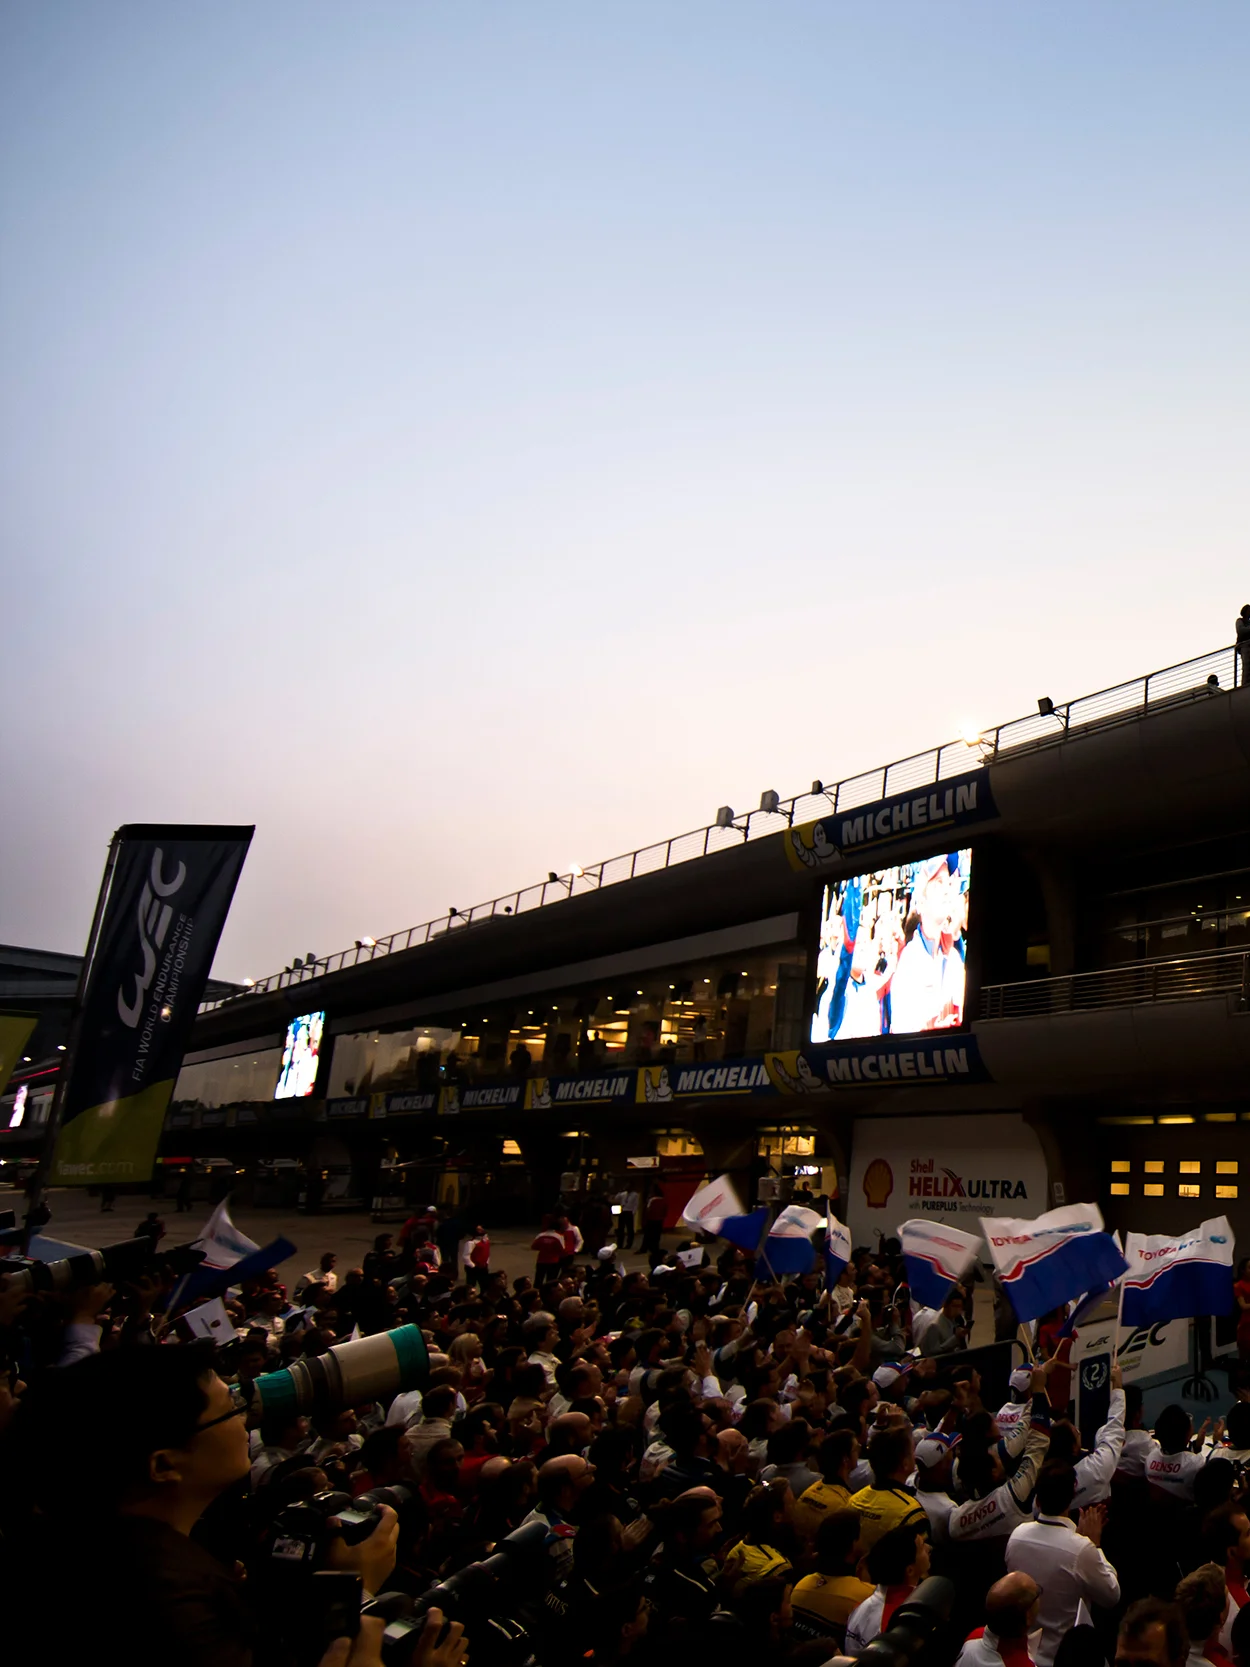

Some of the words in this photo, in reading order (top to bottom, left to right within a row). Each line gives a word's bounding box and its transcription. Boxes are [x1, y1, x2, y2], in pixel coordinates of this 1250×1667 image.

[841, 781, 978, 846] MICHELIN
[118, 847, 187, 1029] WEC
[153, 912, 187, 1003] ENDURANCE
[160, 917, 194, 1023] CHAMPIONSHIP
[138, 1003, 159, 1059] WORLD
[132, 1062, 147, 1082] FIA
[826, 1048, 969, 1083] MICHELIN
[463, 1086, 520, 1106] MICHELIN
[555, 1076, 629, 1100] MICHELIN
[389, 1094, 435, 1112] MICHELIN
[911, 1160, 934, 1173] Shell
[909, 1171, 966, 1197] HELIX
[968, 1180, 1027, 1199] ULTRA
[922, 1201, 957, 1211] PUREPLUS
[959, 1202, 994, 1214] Technology
[1114, 1320, 1166, 1357] EC
[1090, 1361, 1102, 1381] 2
[1150, 1460, 1181, 1474] DENSO
[960, 1500, 996, 1527] DENSO
